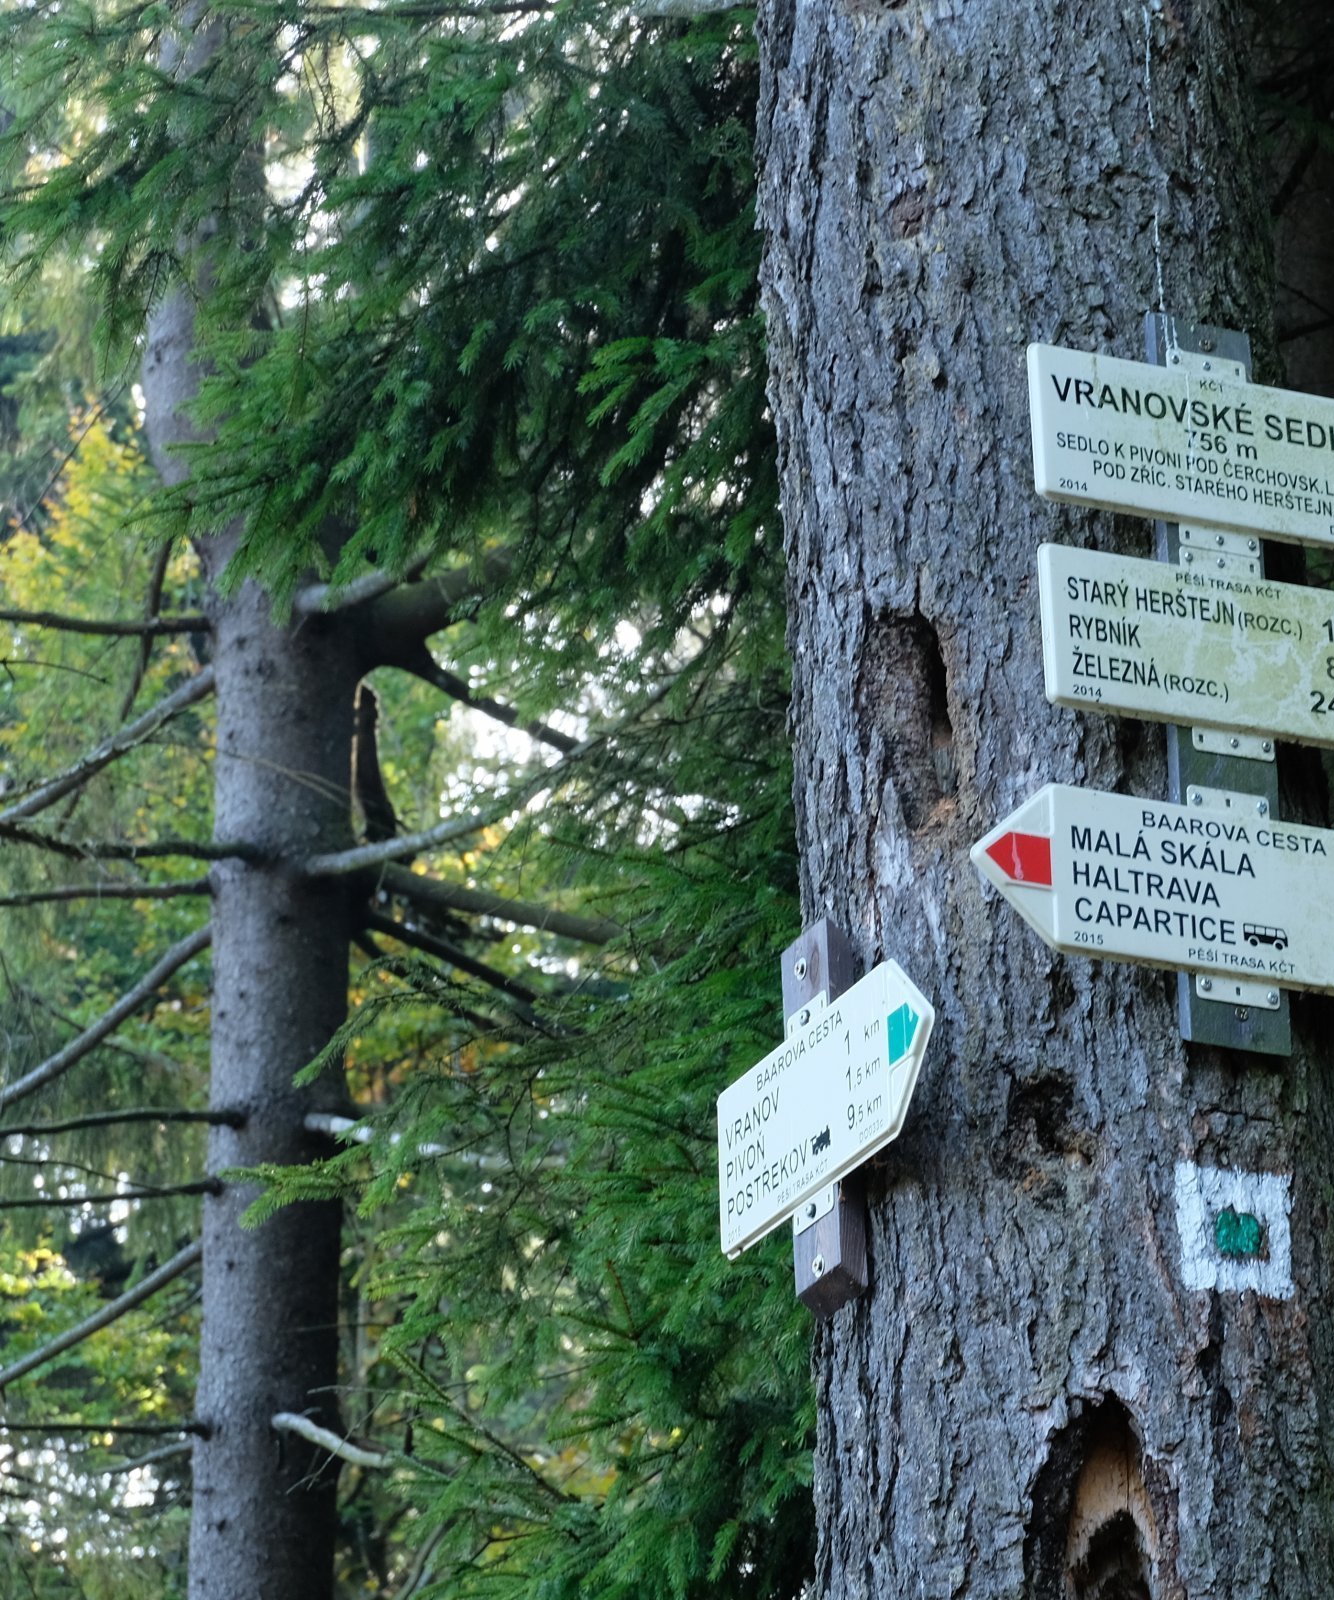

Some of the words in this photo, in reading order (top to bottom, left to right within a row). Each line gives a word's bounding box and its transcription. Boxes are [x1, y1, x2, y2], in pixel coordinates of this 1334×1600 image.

[1051, 374, 1254, 436] VRANOVSKÉ
[1056, 432, 1109, 456] SEDLO
[1114, 442, 1125, 459] K
[1130, 445, 1181, 469] PIVONI
[1186, 455, 1218, 475] POD
[1184, 429, 1228, 454] 756
[1236, 442, 1258, 460] m
[1059, 478, 1088, 492] 2014
[1093, 460, 1126, 480] POD
[1130, 465, 1171, 489] ZŘÍC.
[1175, 474, 1248, 501] STARÉHO
[1208, 578, 1252, 594] TRASA
[1067, 576, 1129, 608] STARÝ
[1322, 619, 1334, 642] 1
[1069, 614, 1141, 648] RYBNÍK
[1072, 645, 1160, 689] ŽELEZNÁ
[1073, 684, 1102, 699] 2014
[1071, 825, 1151, 861] MALÁ
[1161, 840, 1256, 878] SKÁLA
[1142, 811, 1250, 844] BAAROVA
[1256, 830, 1327, 857] CESTA
[1072, 861, 1221, 908] HALTRAVA
[1074, 931, 1104, 945] 2015
[1075, 897, 1237, 945] CAPARTICE
[1222, 953, 1266, 970] TRASA
[1269, 960, 1295, 974] KČT
[756, 1039, 806, 1092] BAAROVA
[808, 1010, 842, 1048] CESTA
[725, 1086, 780, 1151] VRANOV
[844, 1029, 851, 1055] 1
[864, 1019, 880, 1042] km
[726, 1129, 765, 1188] PIVOŇ
[865, 1057, 881, 1079] km
[727, 1138, 808, 1224] POSTŘEKOV
[867, 1094, 882, 1117] km
